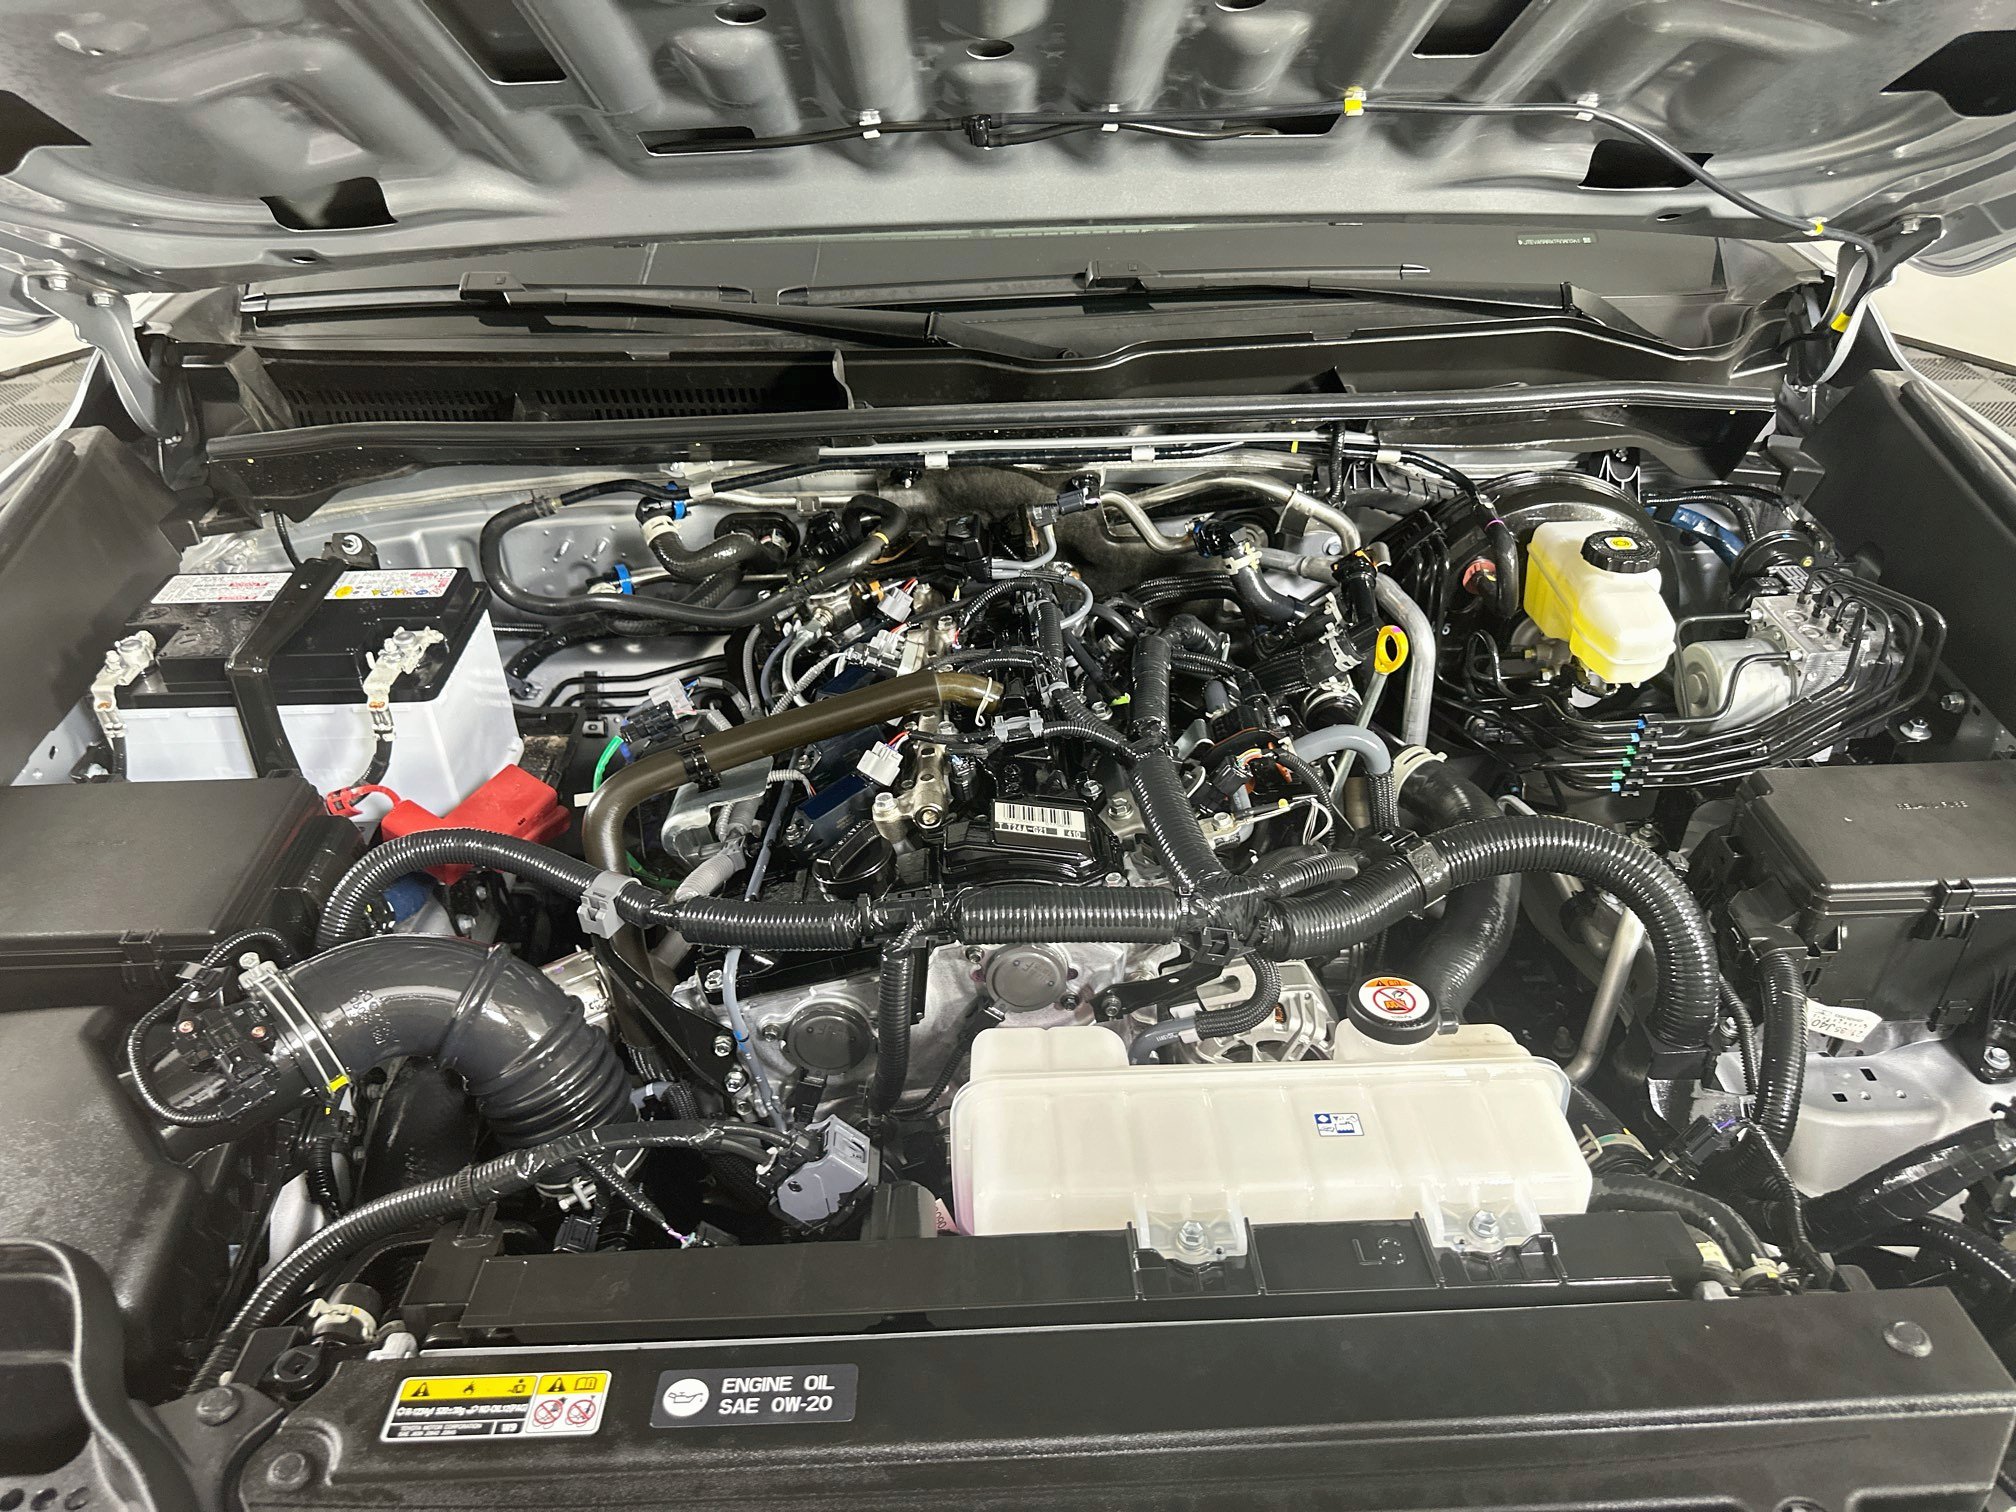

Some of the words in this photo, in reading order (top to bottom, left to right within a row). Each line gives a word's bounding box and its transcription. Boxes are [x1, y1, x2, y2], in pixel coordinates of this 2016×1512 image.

[721, 1376, 794, 1394] ENGINE
[803, 1375, 836, 1391] OIL
[718, 1398, 761, 1415] SAE
[771, 1395, 833, 1413] 0W-20
